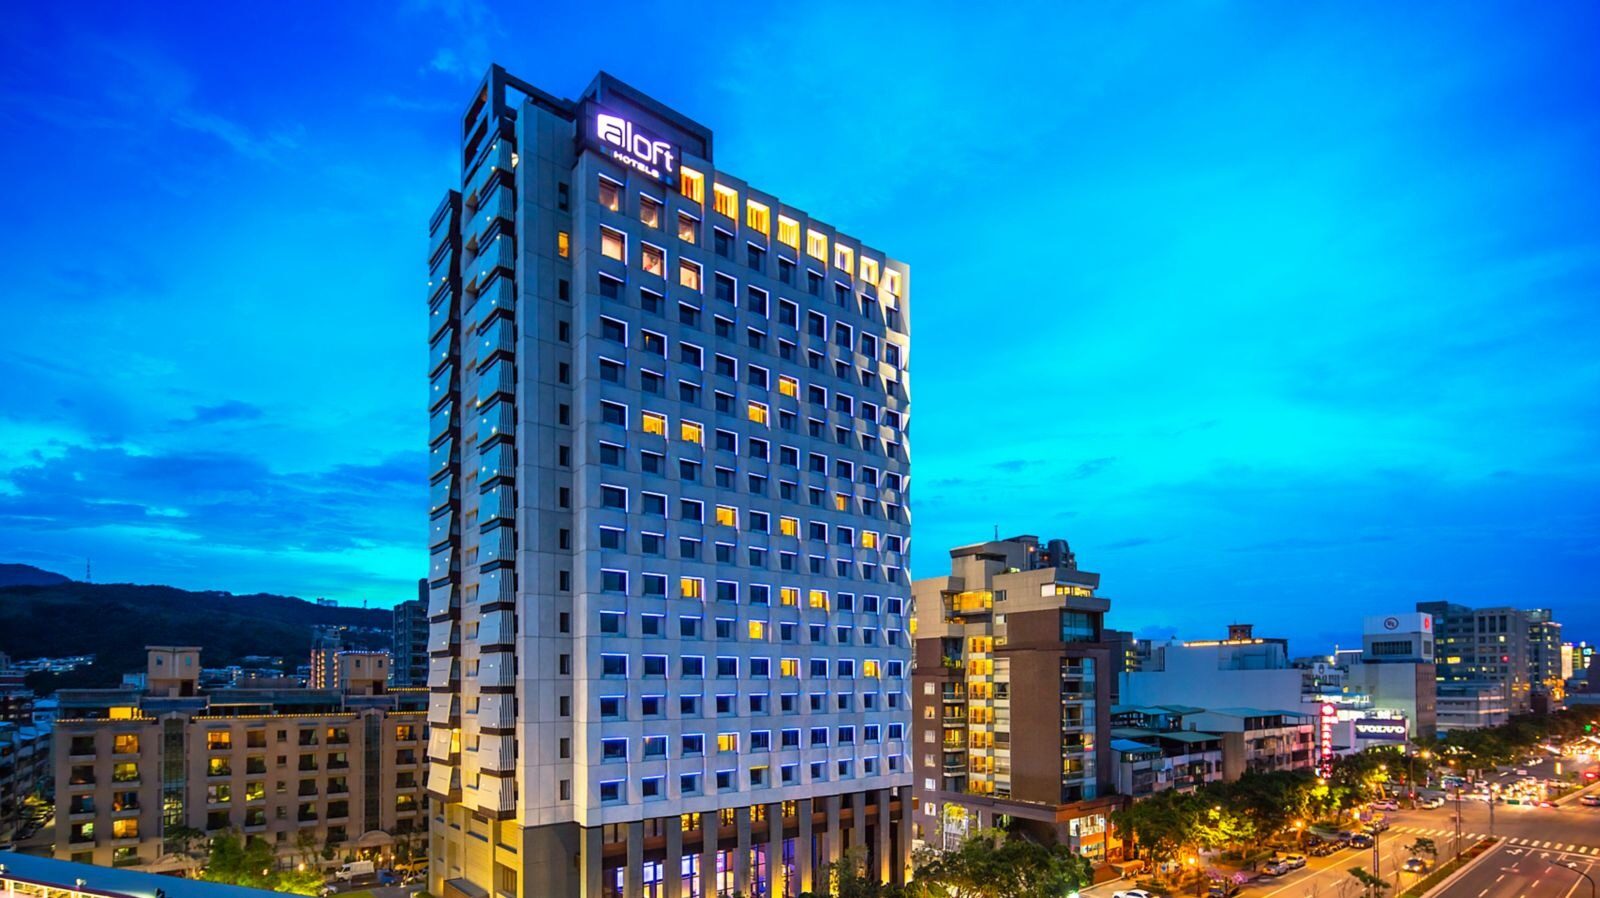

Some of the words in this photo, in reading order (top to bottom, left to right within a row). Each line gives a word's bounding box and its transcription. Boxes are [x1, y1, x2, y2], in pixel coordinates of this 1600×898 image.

[597, 113, 674, 172] aloft
[613, 150, 660, 178] HOTELS
[1356, 725, 1405, 734] VOLVO
